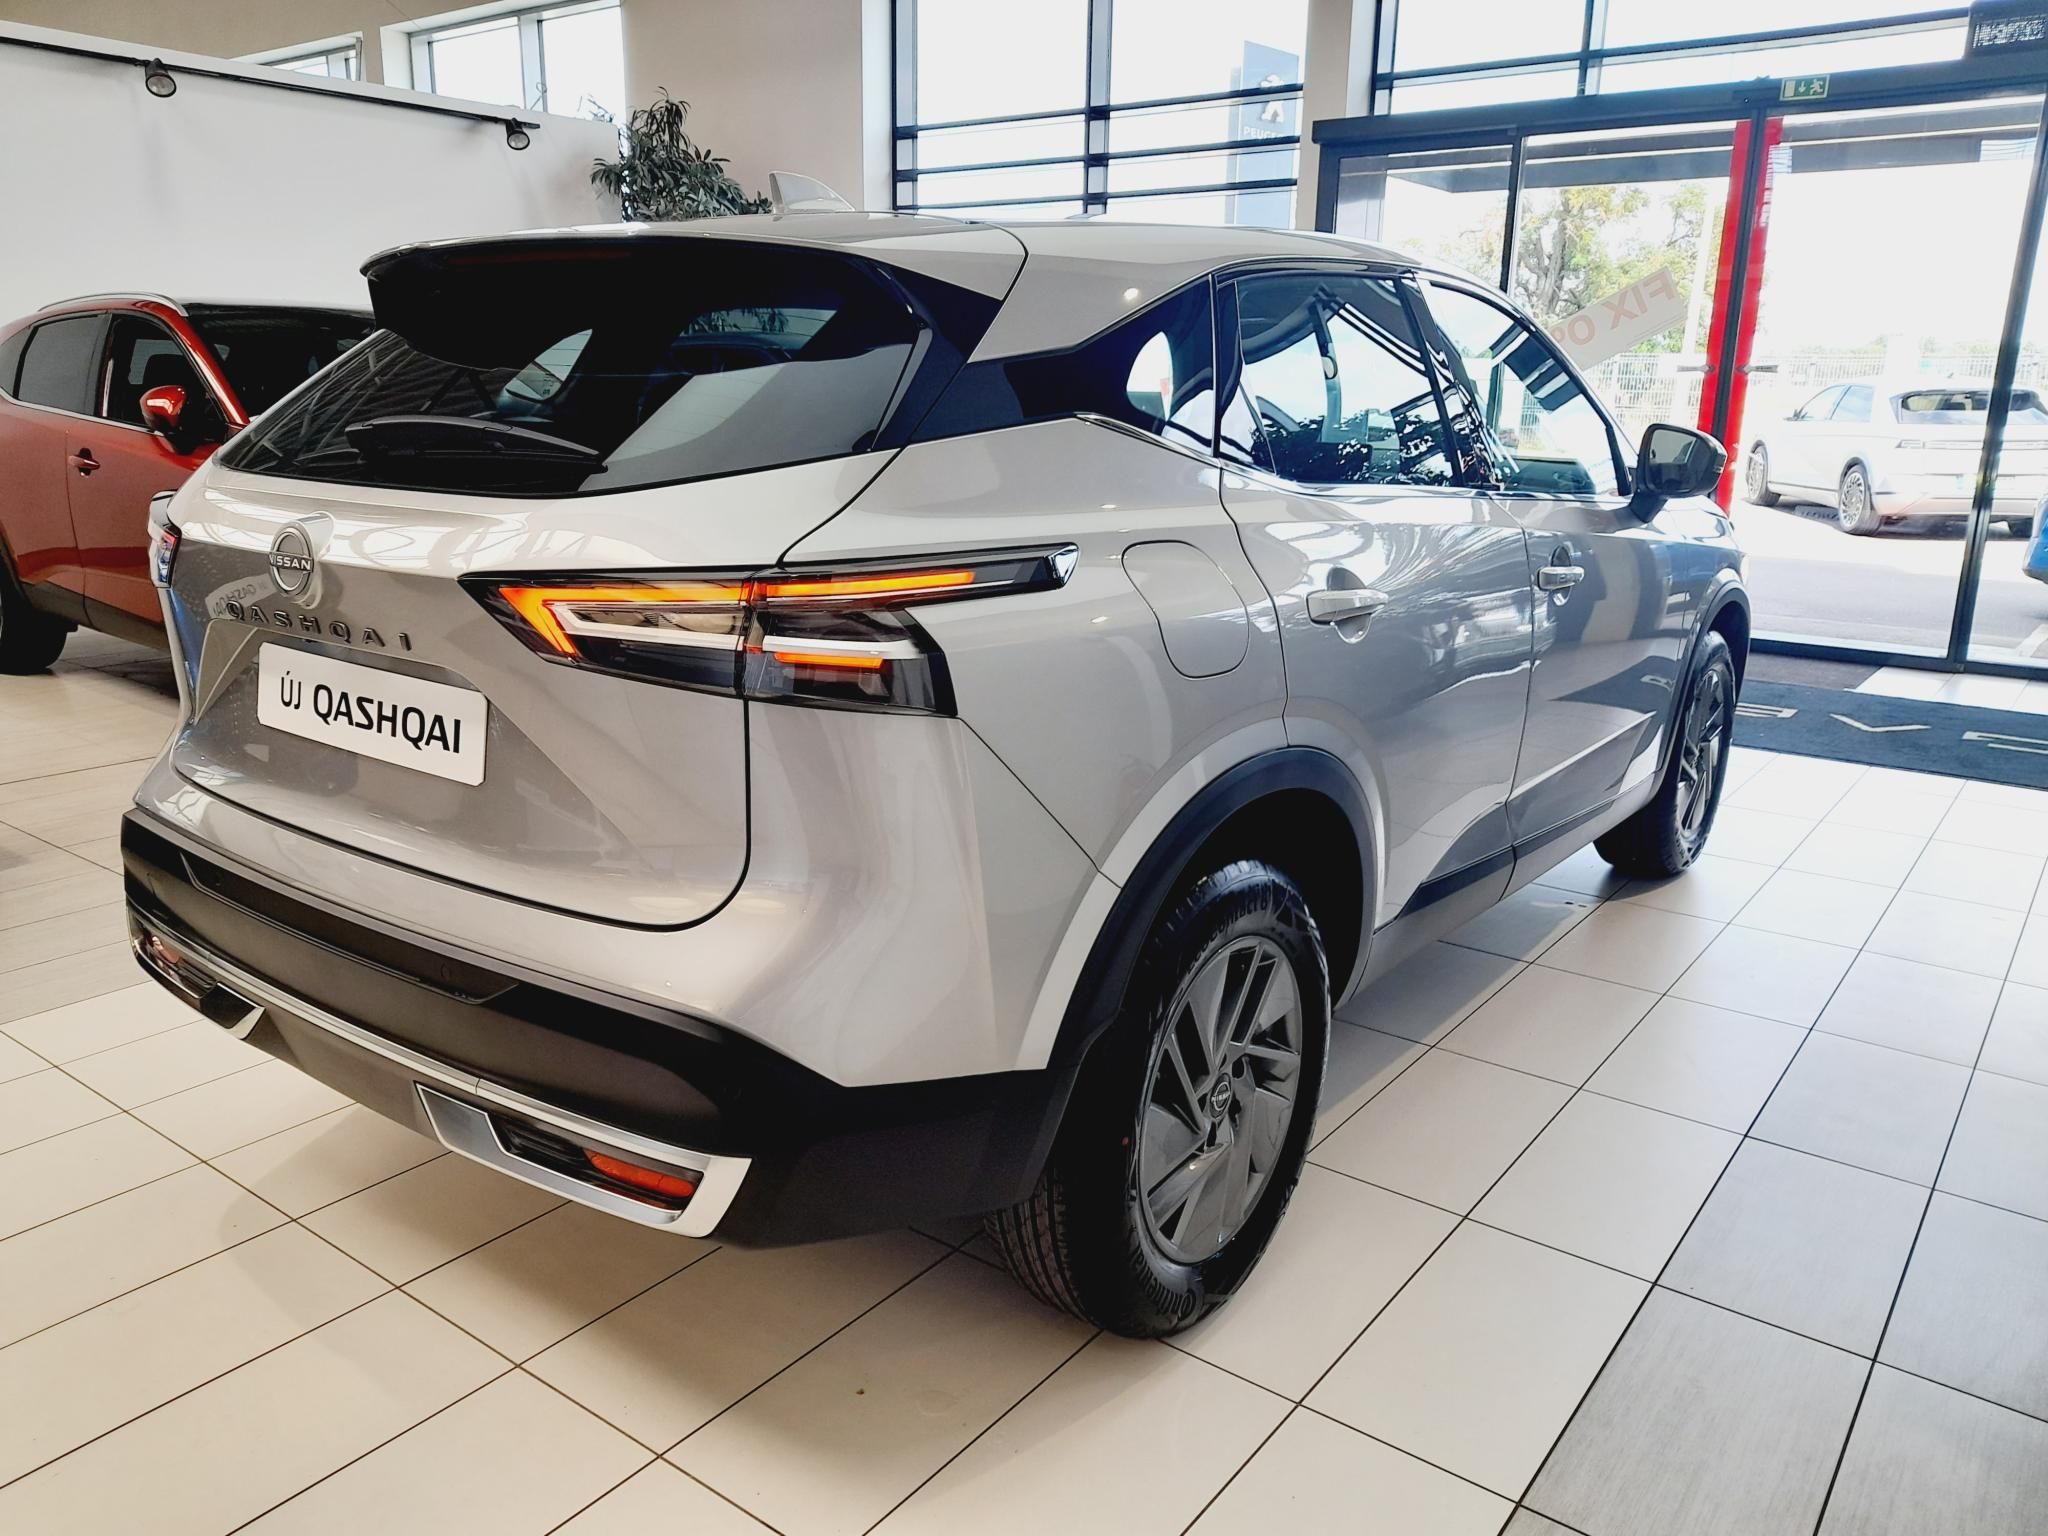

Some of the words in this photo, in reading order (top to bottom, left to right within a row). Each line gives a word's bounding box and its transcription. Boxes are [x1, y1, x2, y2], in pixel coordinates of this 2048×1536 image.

[269, 553, 311, 570] NISSAN
[226, 600, 412, 652] QASHQAI
[280, 670, 302, 711] ÚJ
[313, 684, 462, 754] QASHQAI
